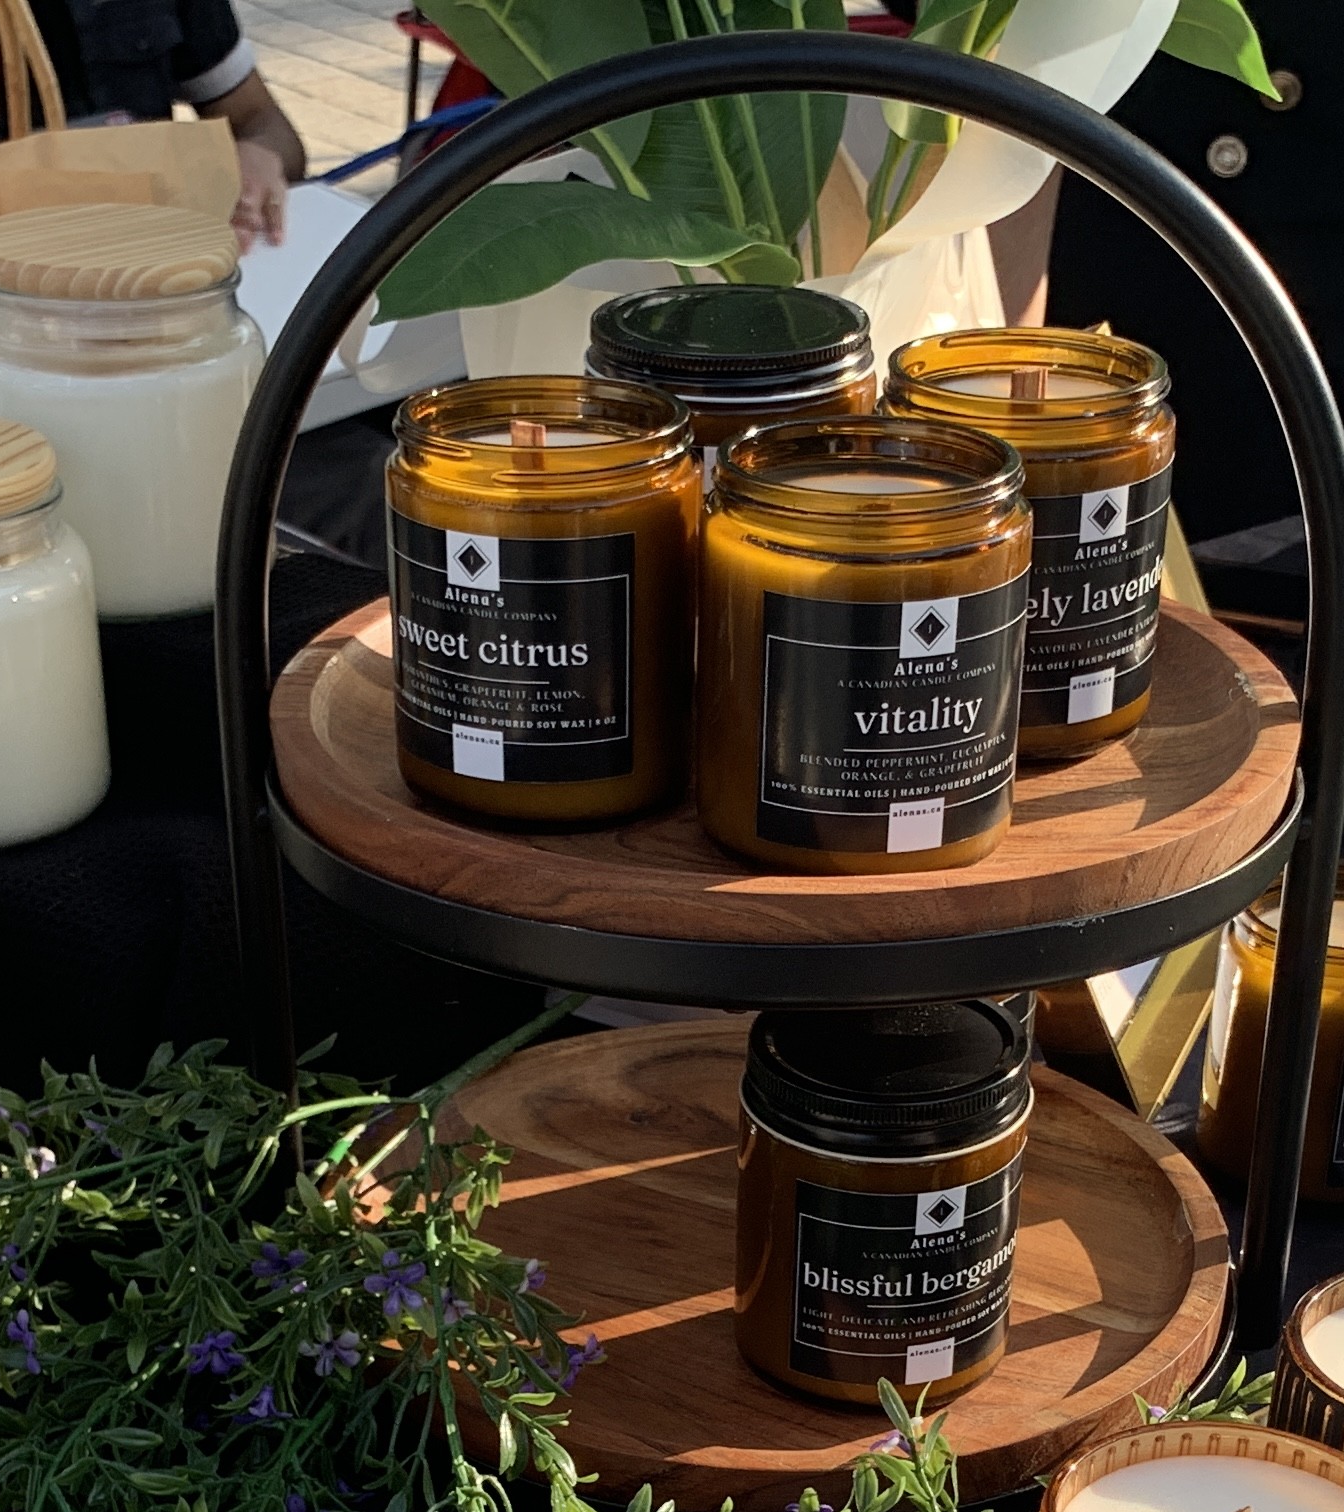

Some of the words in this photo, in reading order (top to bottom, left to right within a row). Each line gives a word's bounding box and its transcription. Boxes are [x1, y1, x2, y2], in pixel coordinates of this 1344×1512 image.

[1074, 538, 1129, 561] Alena's
[444, 587, 505, 608] Alena's
[398, 614, 471, 660] sweet
[478, 633, 590, 667] citrus
[893, 656, 960, 677] Alena's
[847, 678, 909, 690] CANADIAN
[911, 673, 953, 688] CANDLE
[531, 703, 565, 714] ROSE
[853, 695, 984, 735] vitality
[536, 720, 557, 730] SOY
[560, 718, 586, 729] WAX
[799, 753, 861, 769] BLENDED
[770, 780, 797, 793] 100%
[800, 784, 861, 798] ESSENTIAL
[863, 787, 890, 799] OILS
[899, 776, 971, 798] HAND-POURED
[910, 1229, 967, 1250] Alena's
[803, 1261, 913, 1298] blissful
[921, 1229, 1017, 1296] bergamo
[902, 1315, 926, 1326] AND
[828, 1326, 881, 1341] ESSENTIAL
[883, 1331, 906, 1341] OILS
